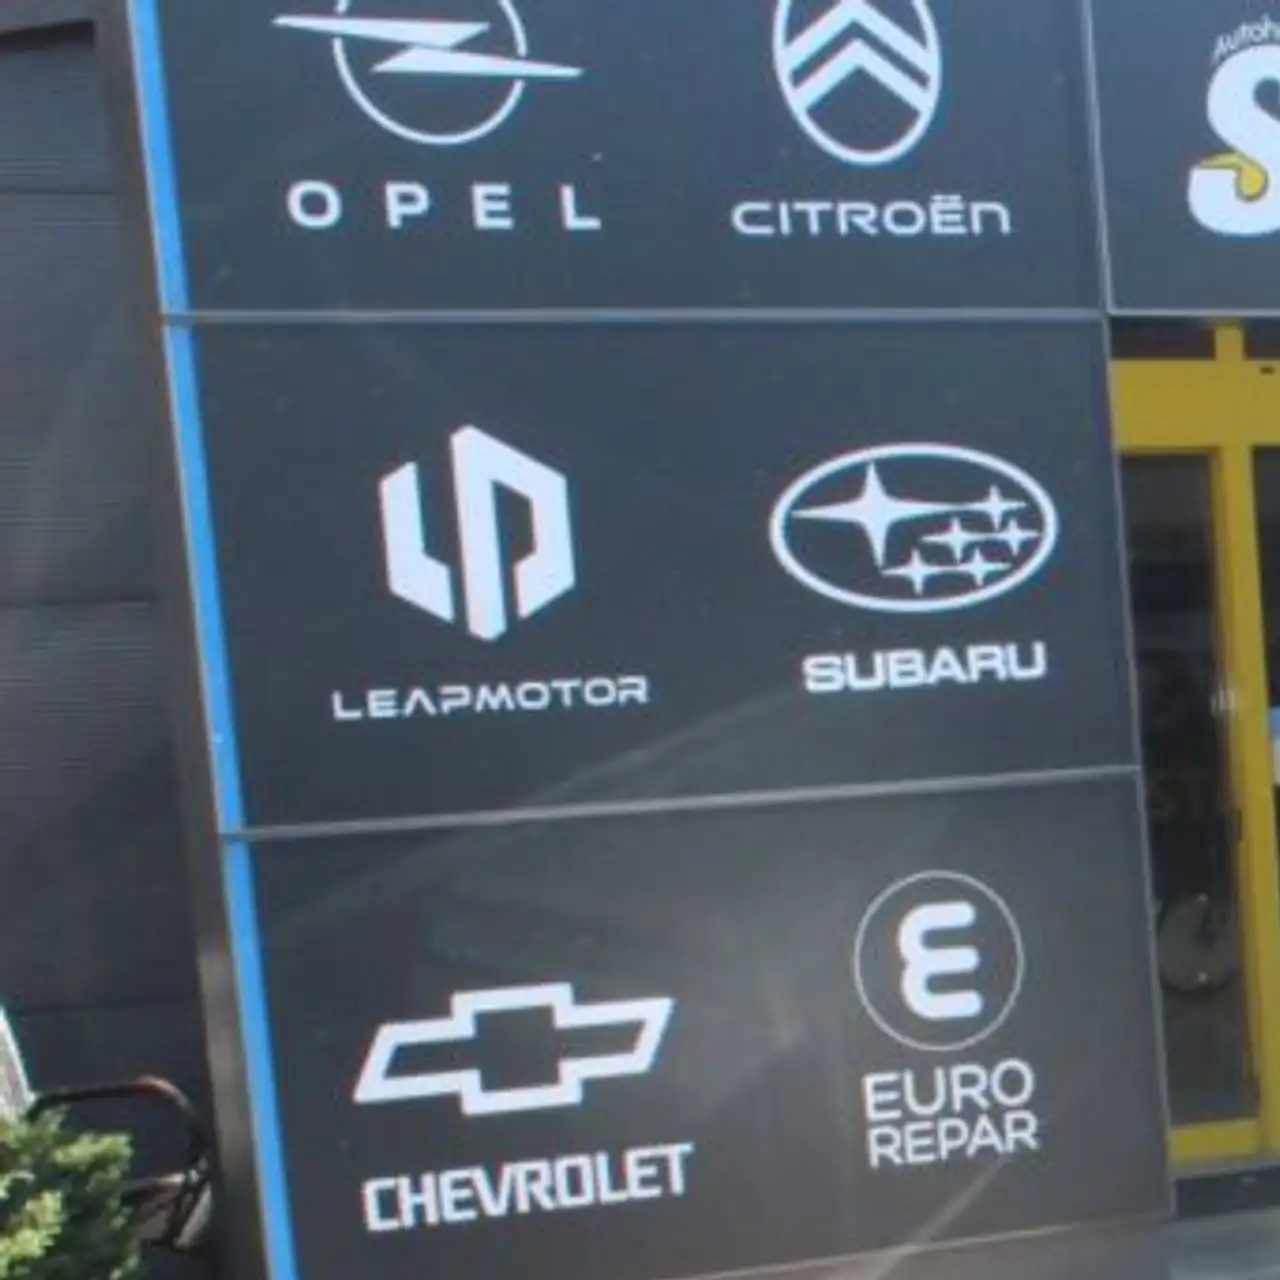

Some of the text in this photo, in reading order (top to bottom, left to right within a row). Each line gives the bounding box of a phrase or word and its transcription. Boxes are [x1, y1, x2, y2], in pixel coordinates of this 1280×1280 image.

[286, 180, 600, 230] OPEL
[731, 194, 1011, 236] CITROËN
[802, 641, 1048, 694] SUBARU
[332, 676, 650, 721] LEAPMOTOR
[863, 1059, 1036, 1124] EURO
[868, 1110, 1041, 1170] REPAR
[361, 1142, 695, 1233] CHEVROLET
